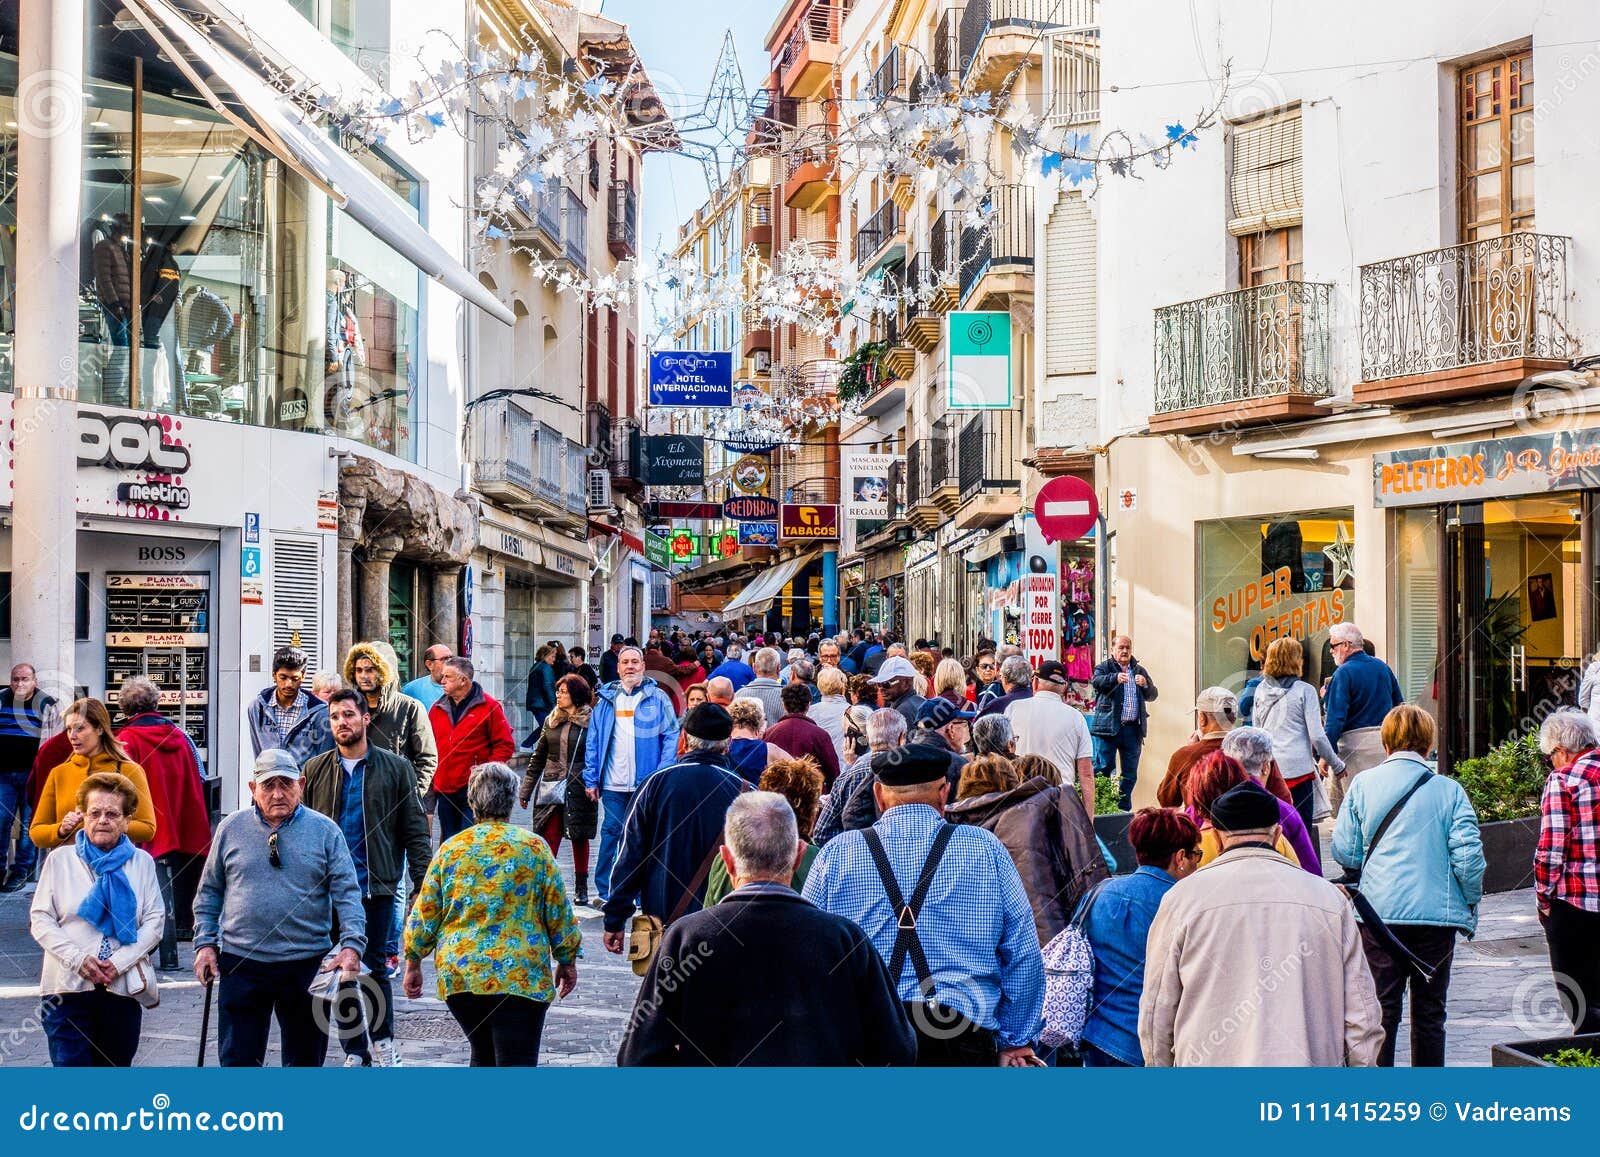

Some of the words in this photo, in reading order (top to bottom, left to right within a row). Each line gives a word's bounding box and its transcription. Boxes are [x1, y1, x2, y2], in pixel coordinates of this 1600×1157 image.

[676, 375, 706, 383] HOTEL
[653, 384, 729, 393] INTERNACIONAL
[281, 401, 307, 416] BOSS
[668, 441, 685, 453] Els
[1382, 453, 1485, 494] PELETEROS
[129, 483, 190, 506] meeting
[725, 500, 776, 516] FREIDURIA
[741, 523, 776, 533] TAPAS
[784, 527, 836, 536] TABACOS
[139, 547, 186, 561] BOSS
[1034, 596, 1048, 608] POR
[1212, 565, 1292, 633] SUPER
[1031, 613, 1052, 624] CIERRE
[1249, 587, 1345, 662] OFERTAS
[1029, 629, 1054, 650] TODO
